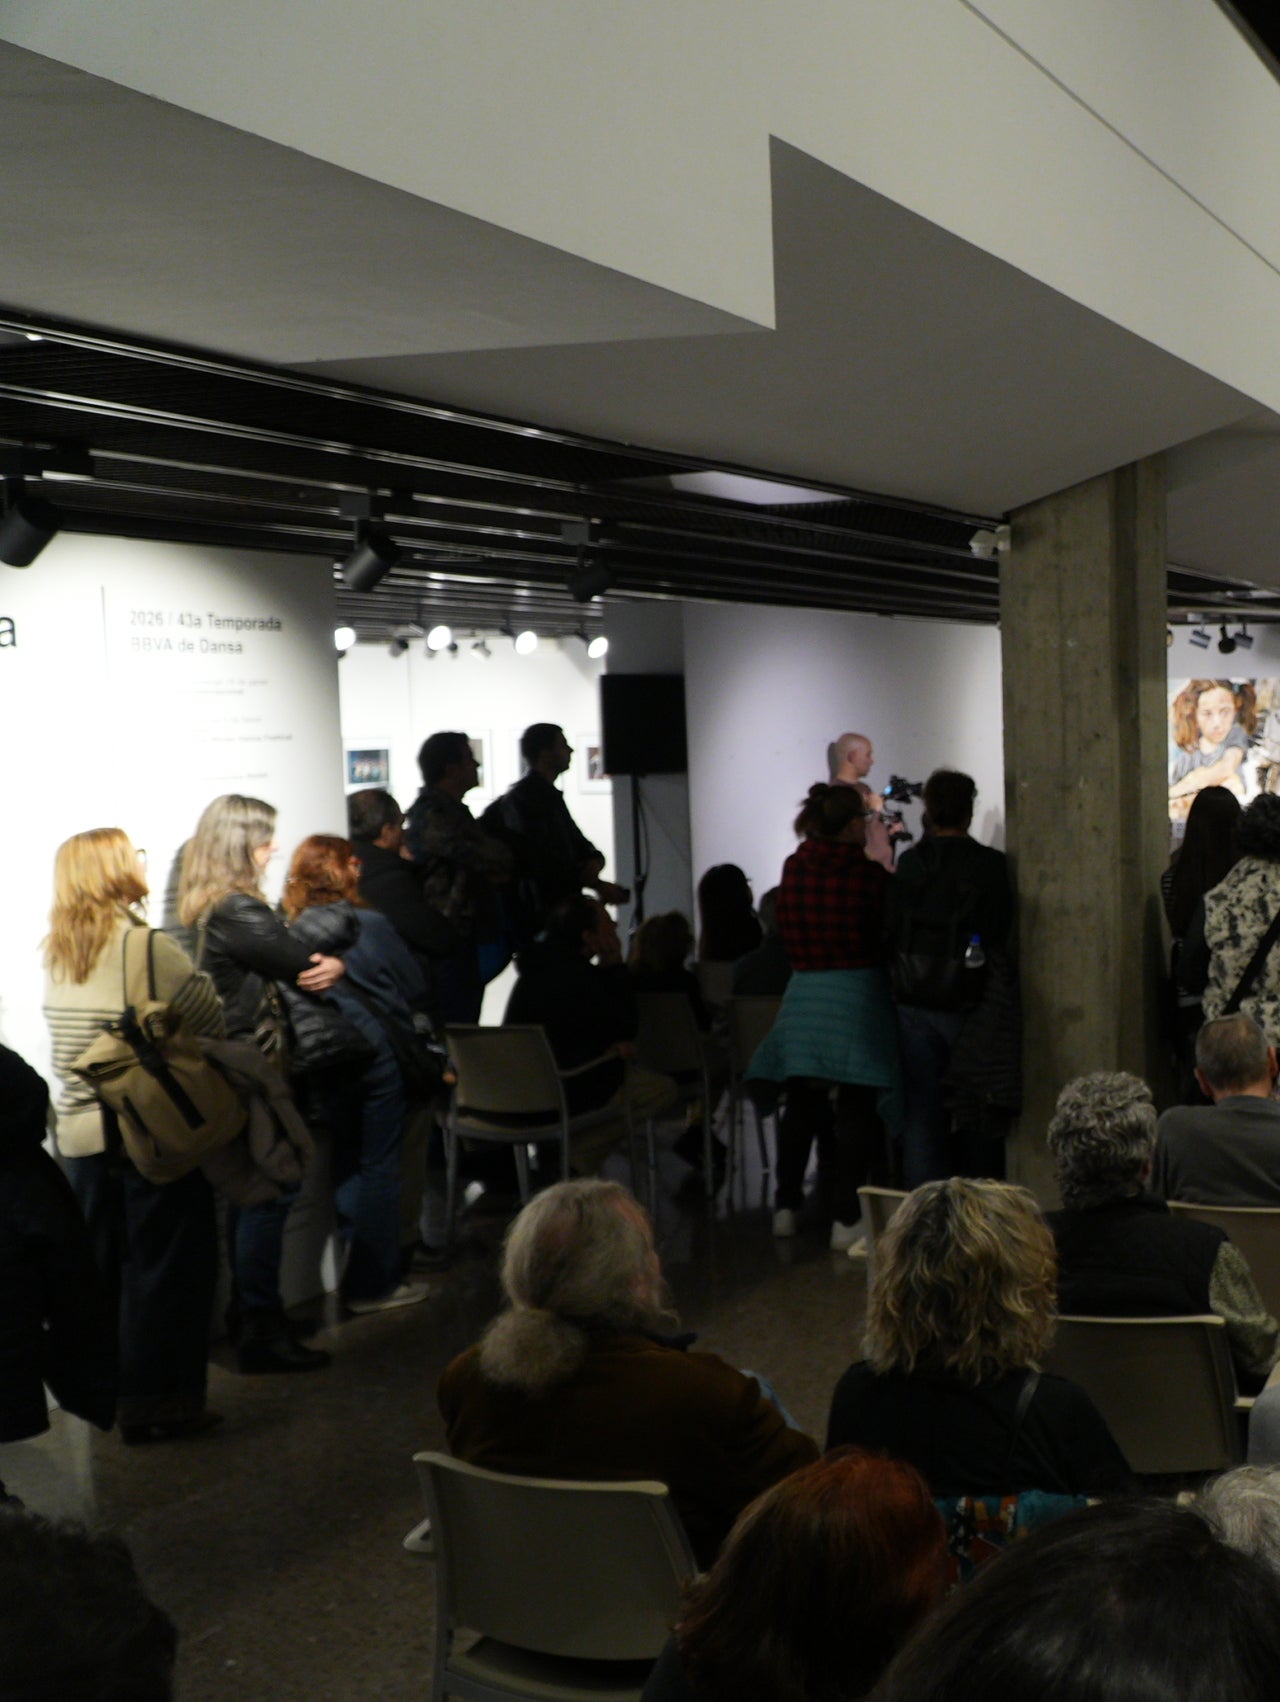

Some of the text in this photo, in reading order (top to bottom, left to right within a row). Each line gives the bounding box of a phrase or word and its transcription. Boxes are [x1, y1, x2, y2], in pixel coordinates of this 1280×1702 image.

[129, 610, 163, 626] 2026
[177, 612, 202, 628] 43a
[206, 612, 283, 633] Temporada
[131, 636, 243, 655] BBVA de Dansa
